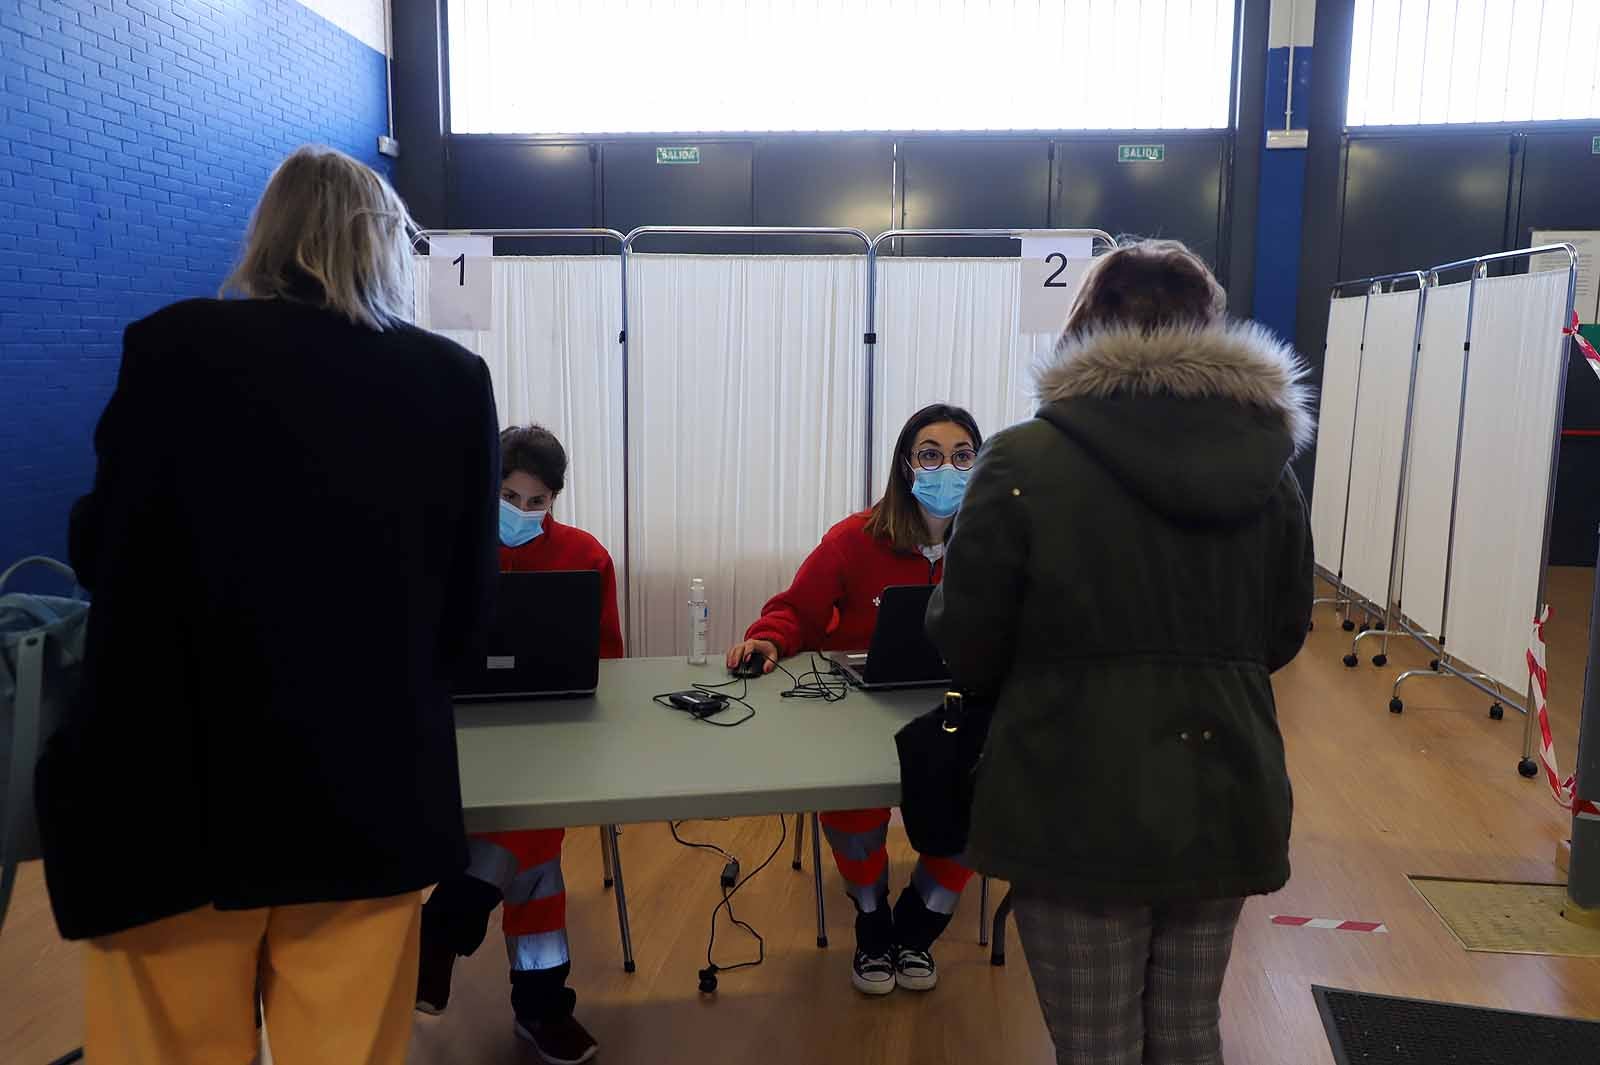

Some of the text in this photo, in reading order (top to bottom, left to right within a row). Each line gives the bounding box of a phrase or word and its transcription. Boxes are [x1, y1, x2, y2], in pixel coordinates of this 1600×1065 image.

[662, 150, 696, 160] SALIDA
[1123, 148, 1159, 158] SALIDA
[452, 253, 465, 286] 1
[1044, 252, 1067, 288] 2
